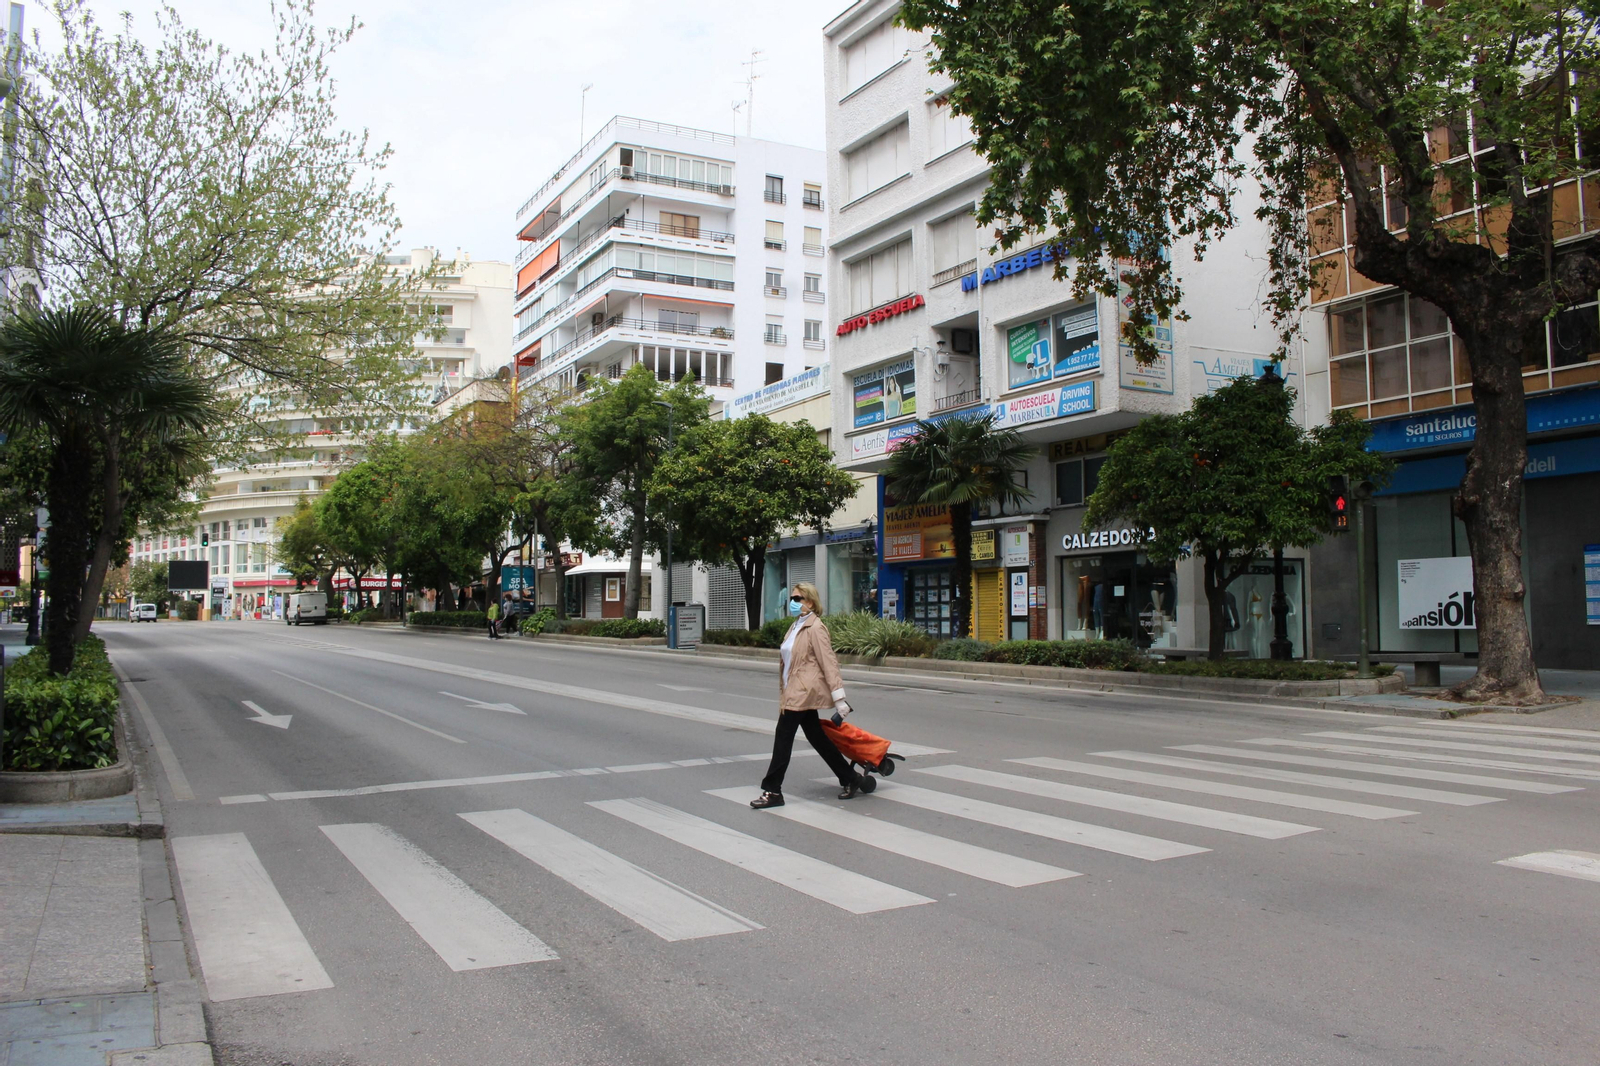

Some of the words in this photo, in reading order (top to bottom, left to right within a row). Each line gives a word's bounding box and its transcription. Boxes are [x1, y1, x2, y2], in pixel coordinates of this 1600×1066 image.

[836, 316, 868, 336] AUTO
[868, 294, 925, 324] ESCUELA
[1055, 361, 1100, 374] WWW.MARBESULA.CO
[1071, 356, 1080, 365] 952
[1081, 354, 1088, 362] 77
[1088, 352, 1094, 360] 71
[1212, 357, 1249, 375] AMELIA
[1230, 358, 1250, 366] VIAJES
[854, 371, 877, 386] ESCUELA
[887, 359, 914, 375] IDIOMAS
[735, 394, 754, 406] CENTRO
[755, 390, 762, 398] DE
[763, 379, 791, 396] PERSONAS
[793, 367, 820, 385] MAYORES
[781, 389, 787, 397] DE
[788, 380, 814, 395] MARBELLA
[1062, 386, 1090, 400] DRIVING
[1010, 393, 1056, 412] AUTOESCUELA
[1062, 399, 1091, 413] SCHOOL
[1010, 405, 1056, 424] MARBESULA
[889, 426, 912, 439] ACADEMIA
[1406, 415, 1477, 436] santaluc
[861, 433, 885, 451] Aenfis
[1434, 432, 1462, 441] SEGUROS
[1054, 439, 1094, 457] REAL
[1524, 456, 1556, 474] dell
[886, 507, 913, 522] VIAJES
[915, 504, 947, 518] AMELIA
[1062, 527, 1156, 550] CALZEDONA
[893, 547, 898, 556] DE
[898, 545, 913, 555] VIAJES
[361, 580, 387, 588] BURGER
